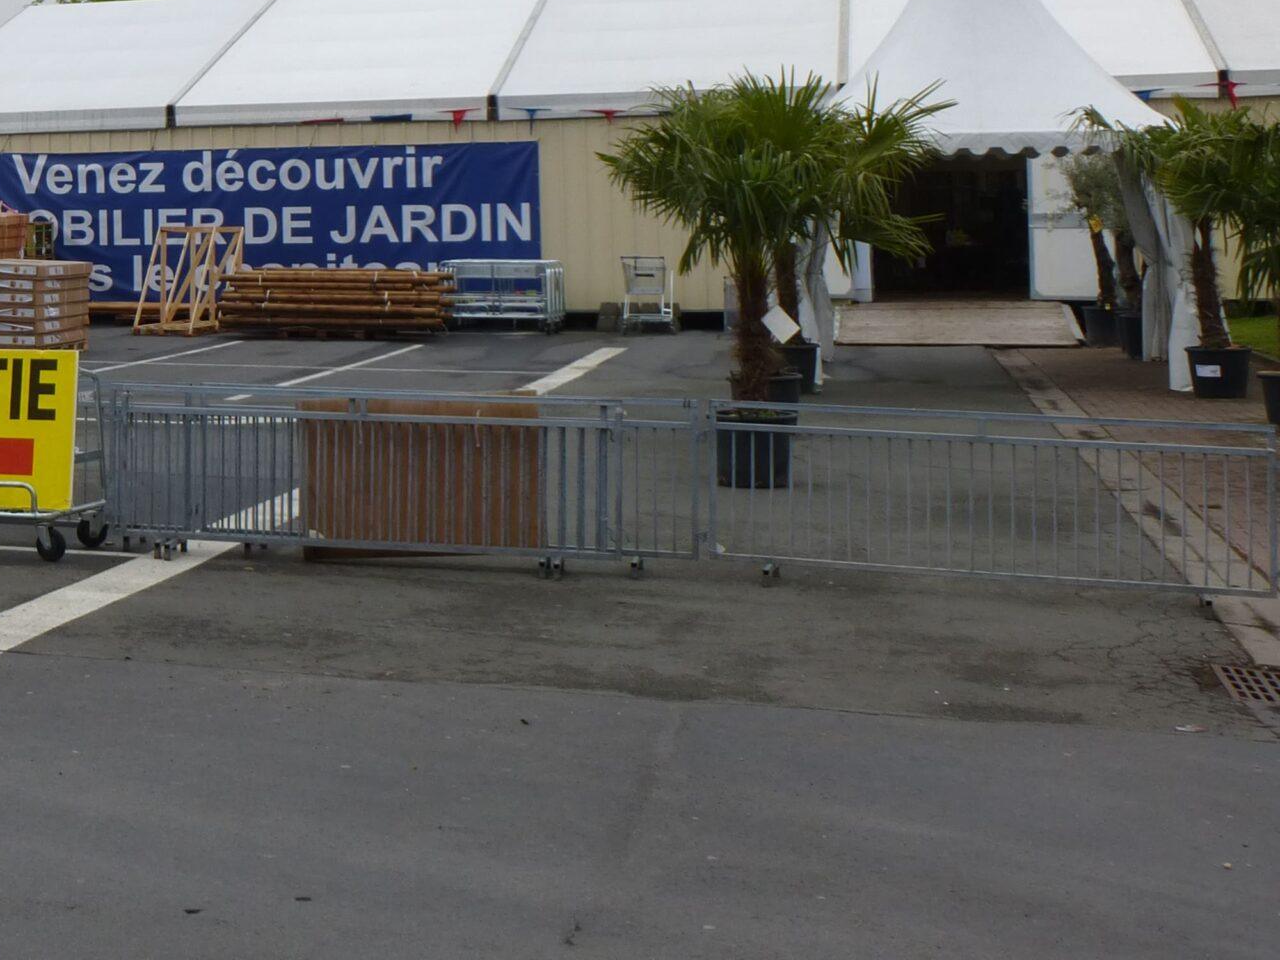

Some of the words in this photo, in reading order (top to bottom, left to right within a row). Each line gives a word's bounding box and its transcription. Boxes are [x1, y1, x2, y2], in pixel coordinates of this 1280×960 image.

[12, 153, 166, 195] Venez
[182, 146, 443, 192] découvrir
[28, 207, 228, 247] OBILIER
[243, 205, 314, 245] DE
[329, 201, 532, 244] JARDIN
[133, 254, 175, 292] le
